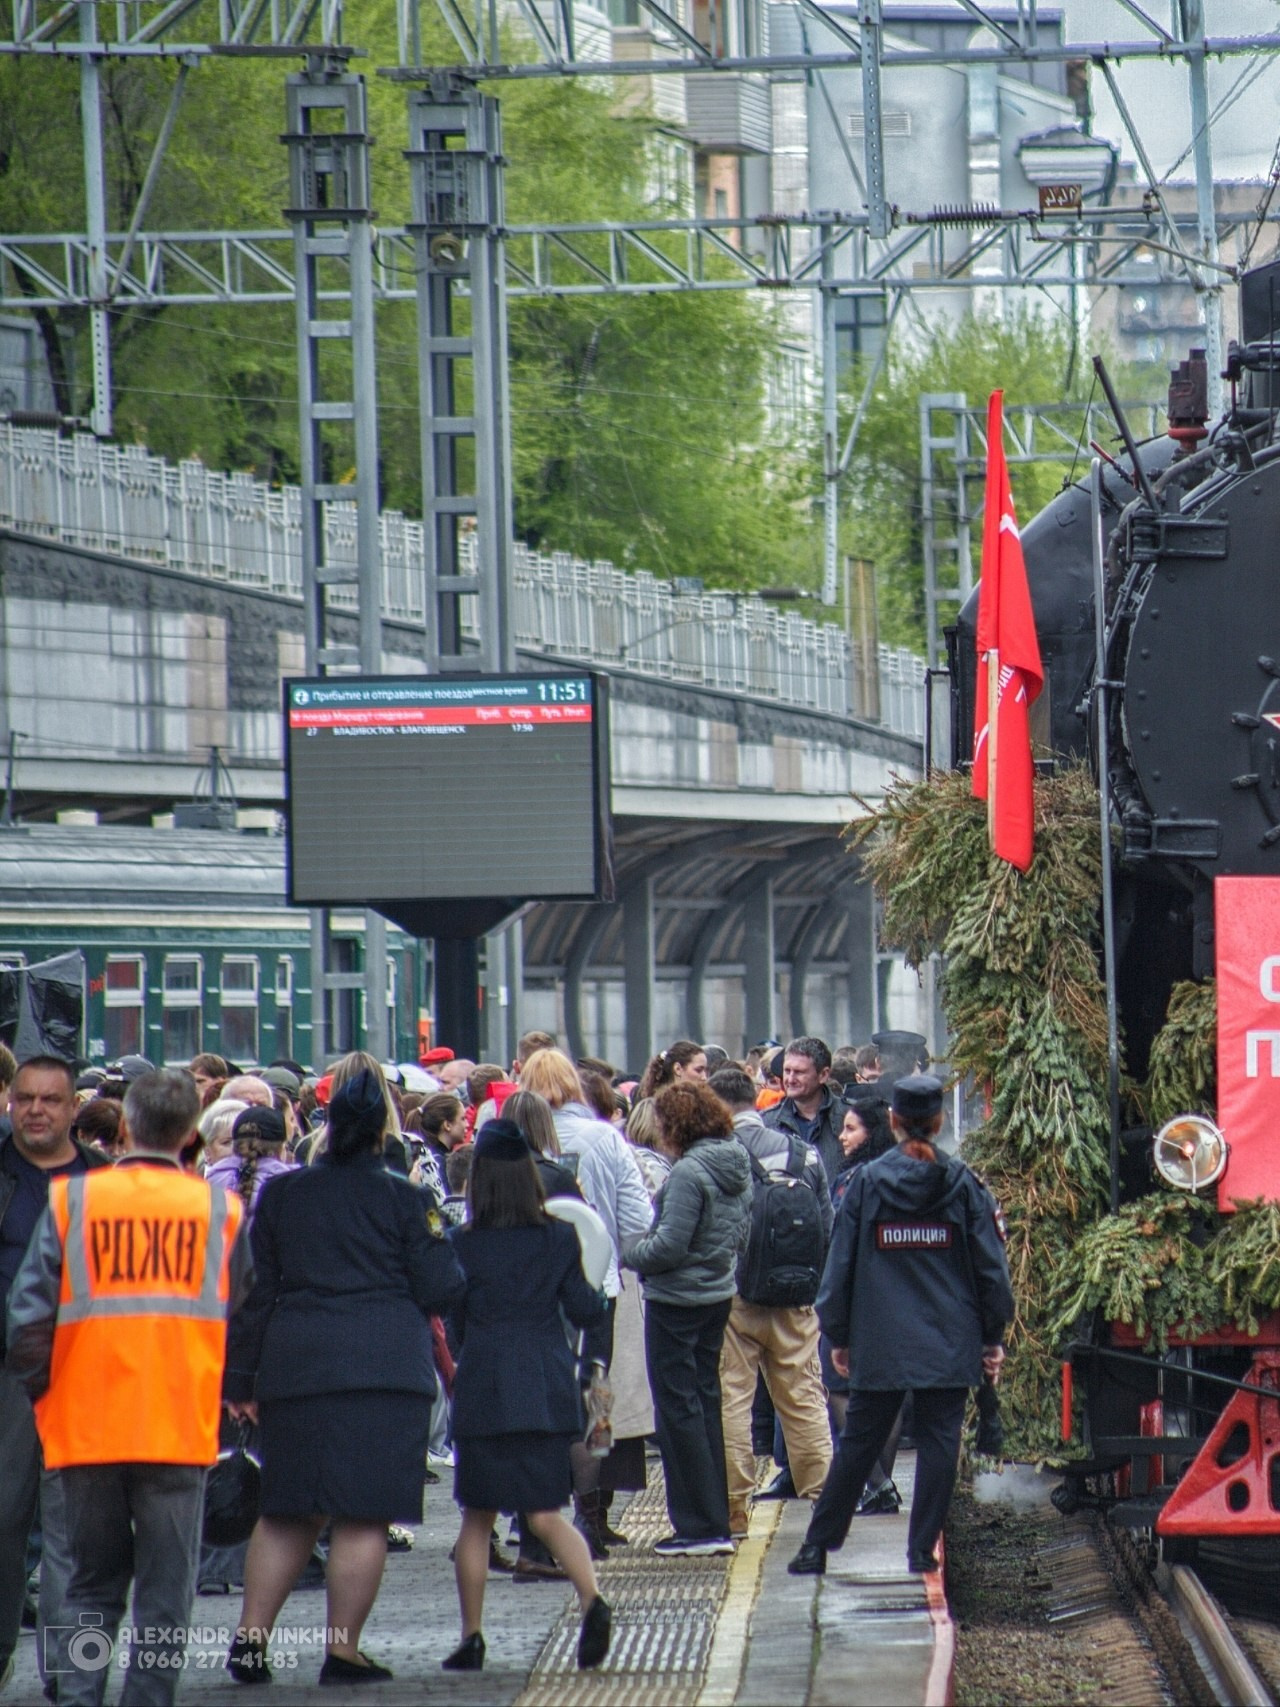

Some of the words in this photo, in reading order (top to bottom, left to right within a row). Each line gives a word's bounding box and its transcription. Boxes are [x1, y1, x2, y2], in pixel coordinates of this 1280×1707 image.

[312, 690, 361, 702] Прибытие
[363, 691, 370, 699] и
[371, 689, 432, 701] отправление
[434, 689, 474, 699] поездов
[538, 683, 586, 701] 11:51
[333, 726, 395, 735] ВЛАДИВОСТОК
[401, 724, 466, 734] БЛАГОВЕЩЕНСК
[883, 1229, 947, 1244] ПОЛИЦИЯ
